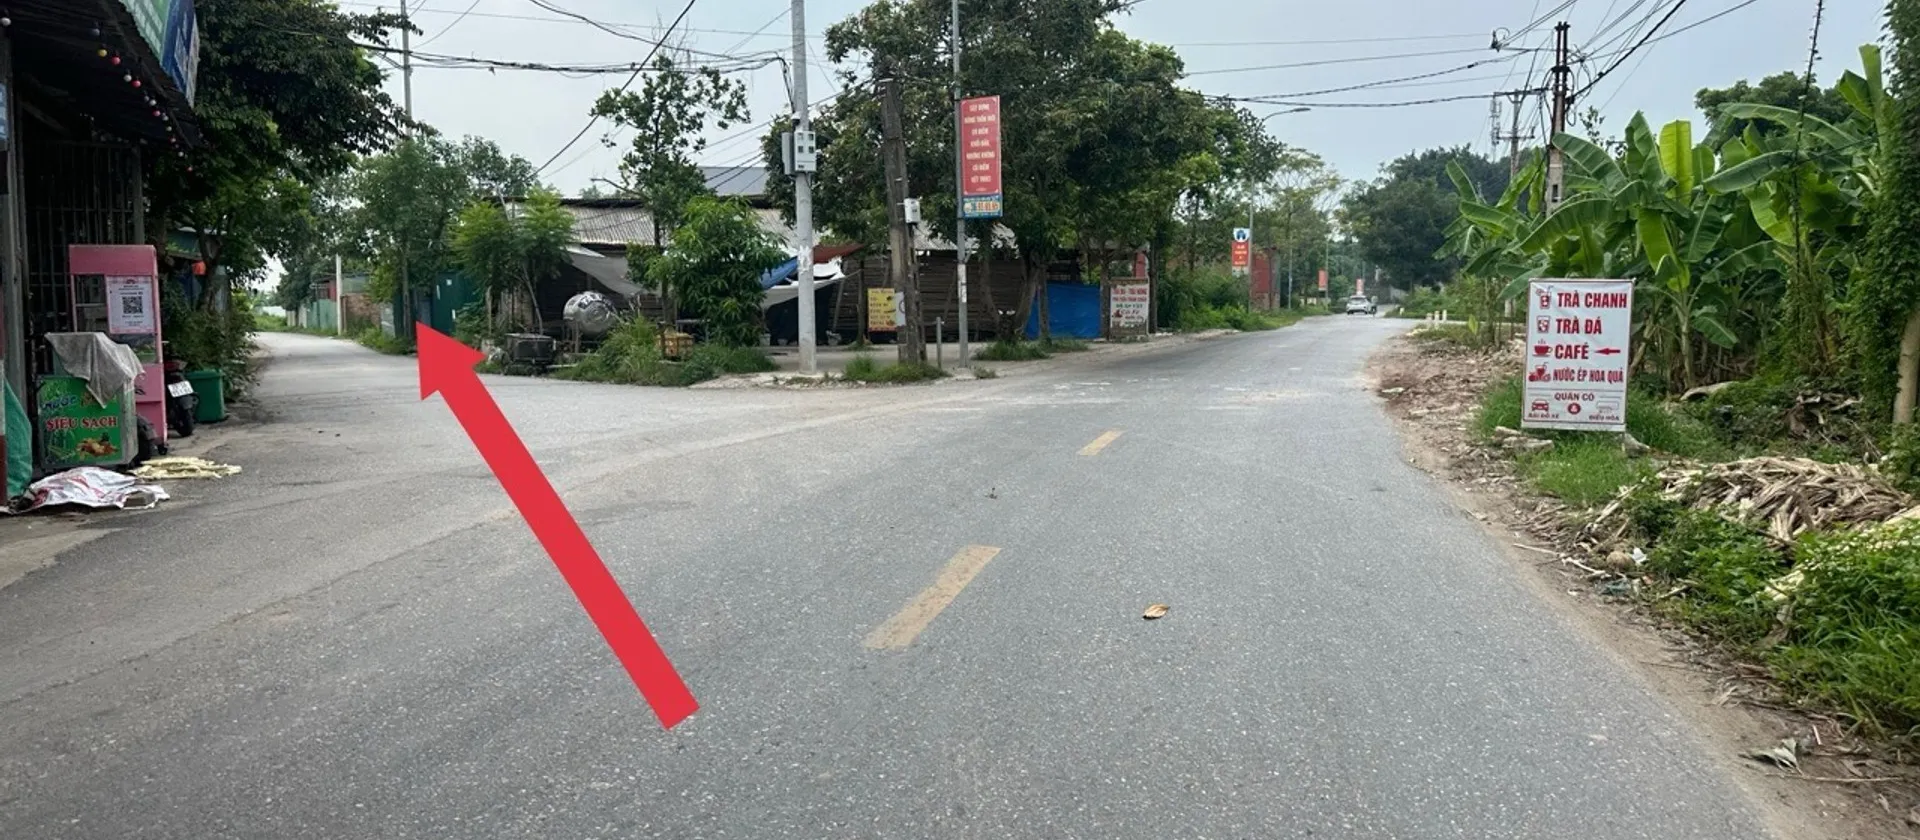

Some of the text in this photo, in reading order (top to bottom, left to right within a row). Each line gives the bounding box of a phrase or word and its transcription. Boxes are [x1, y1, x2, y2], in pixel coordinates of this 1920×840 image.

[1557, 290, 1627, 308] TRÀ CHANH
[1556, 316, 1602, 334] TRÀ ĐÁ
[1552, 366, 1624, 385] NƯỚC ÉP HOA QUẢ
